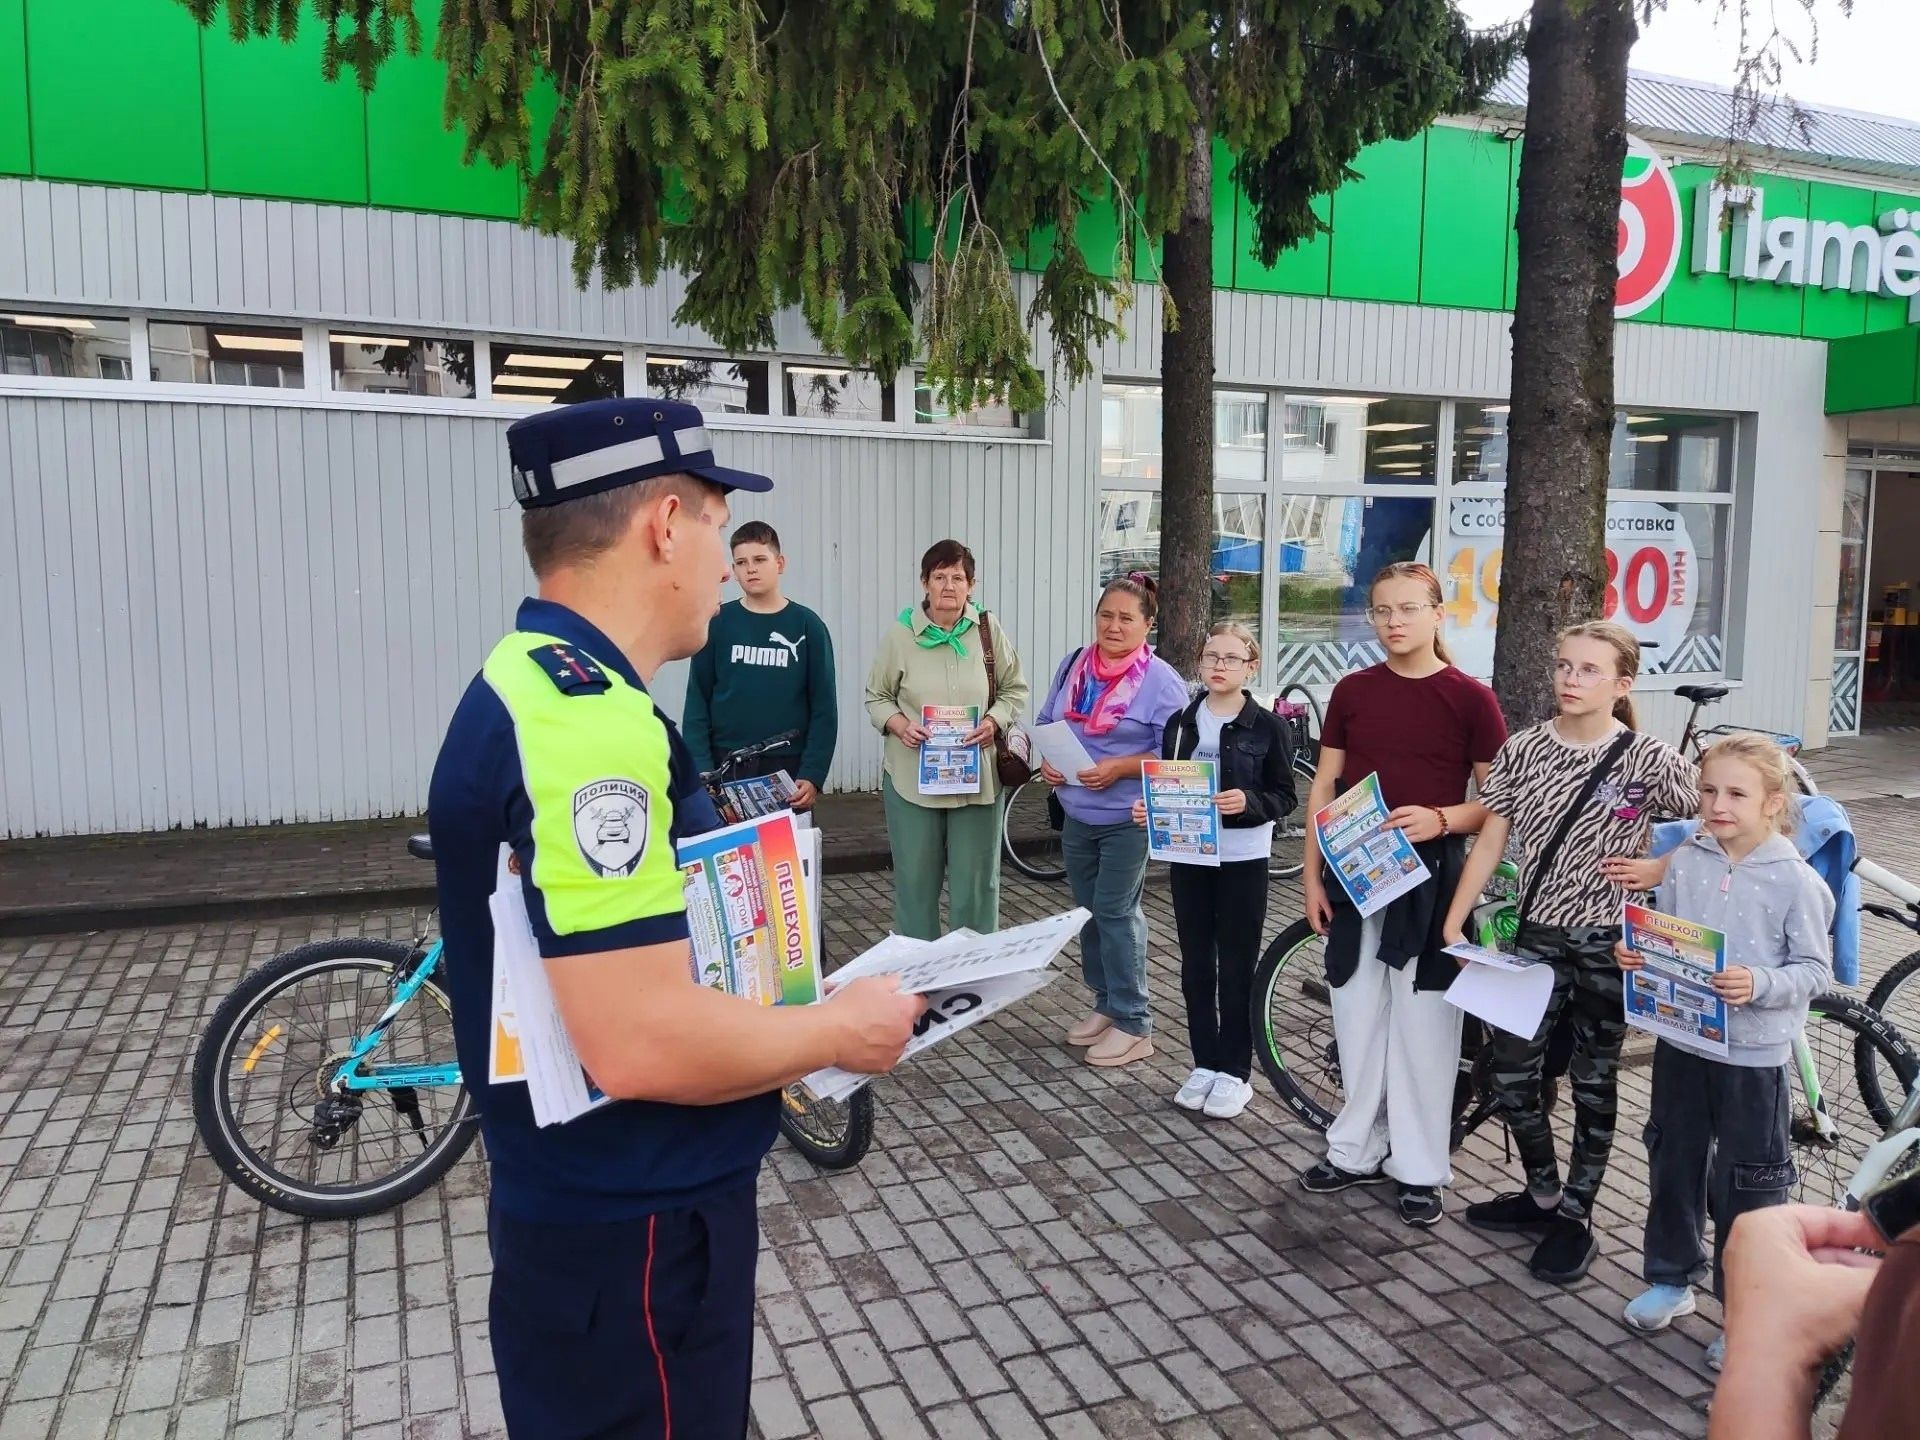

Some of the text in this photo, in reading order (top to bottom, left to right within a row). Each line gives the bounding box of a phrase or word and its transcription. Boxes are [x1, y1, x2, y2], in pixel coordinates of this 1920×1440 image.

[731, 644, 789, 668] PUMA
[579, 783, 645, 804] ПОЛИЦИЯ
[775, 861, 804, 970] ПЕШЕХОД!
[1645, 914, 1703, 940] ПЕШЕХОД!
[1846, 1008, 1907, 1056] STELS
[236, 1163, 286, 1198] INNOVA
